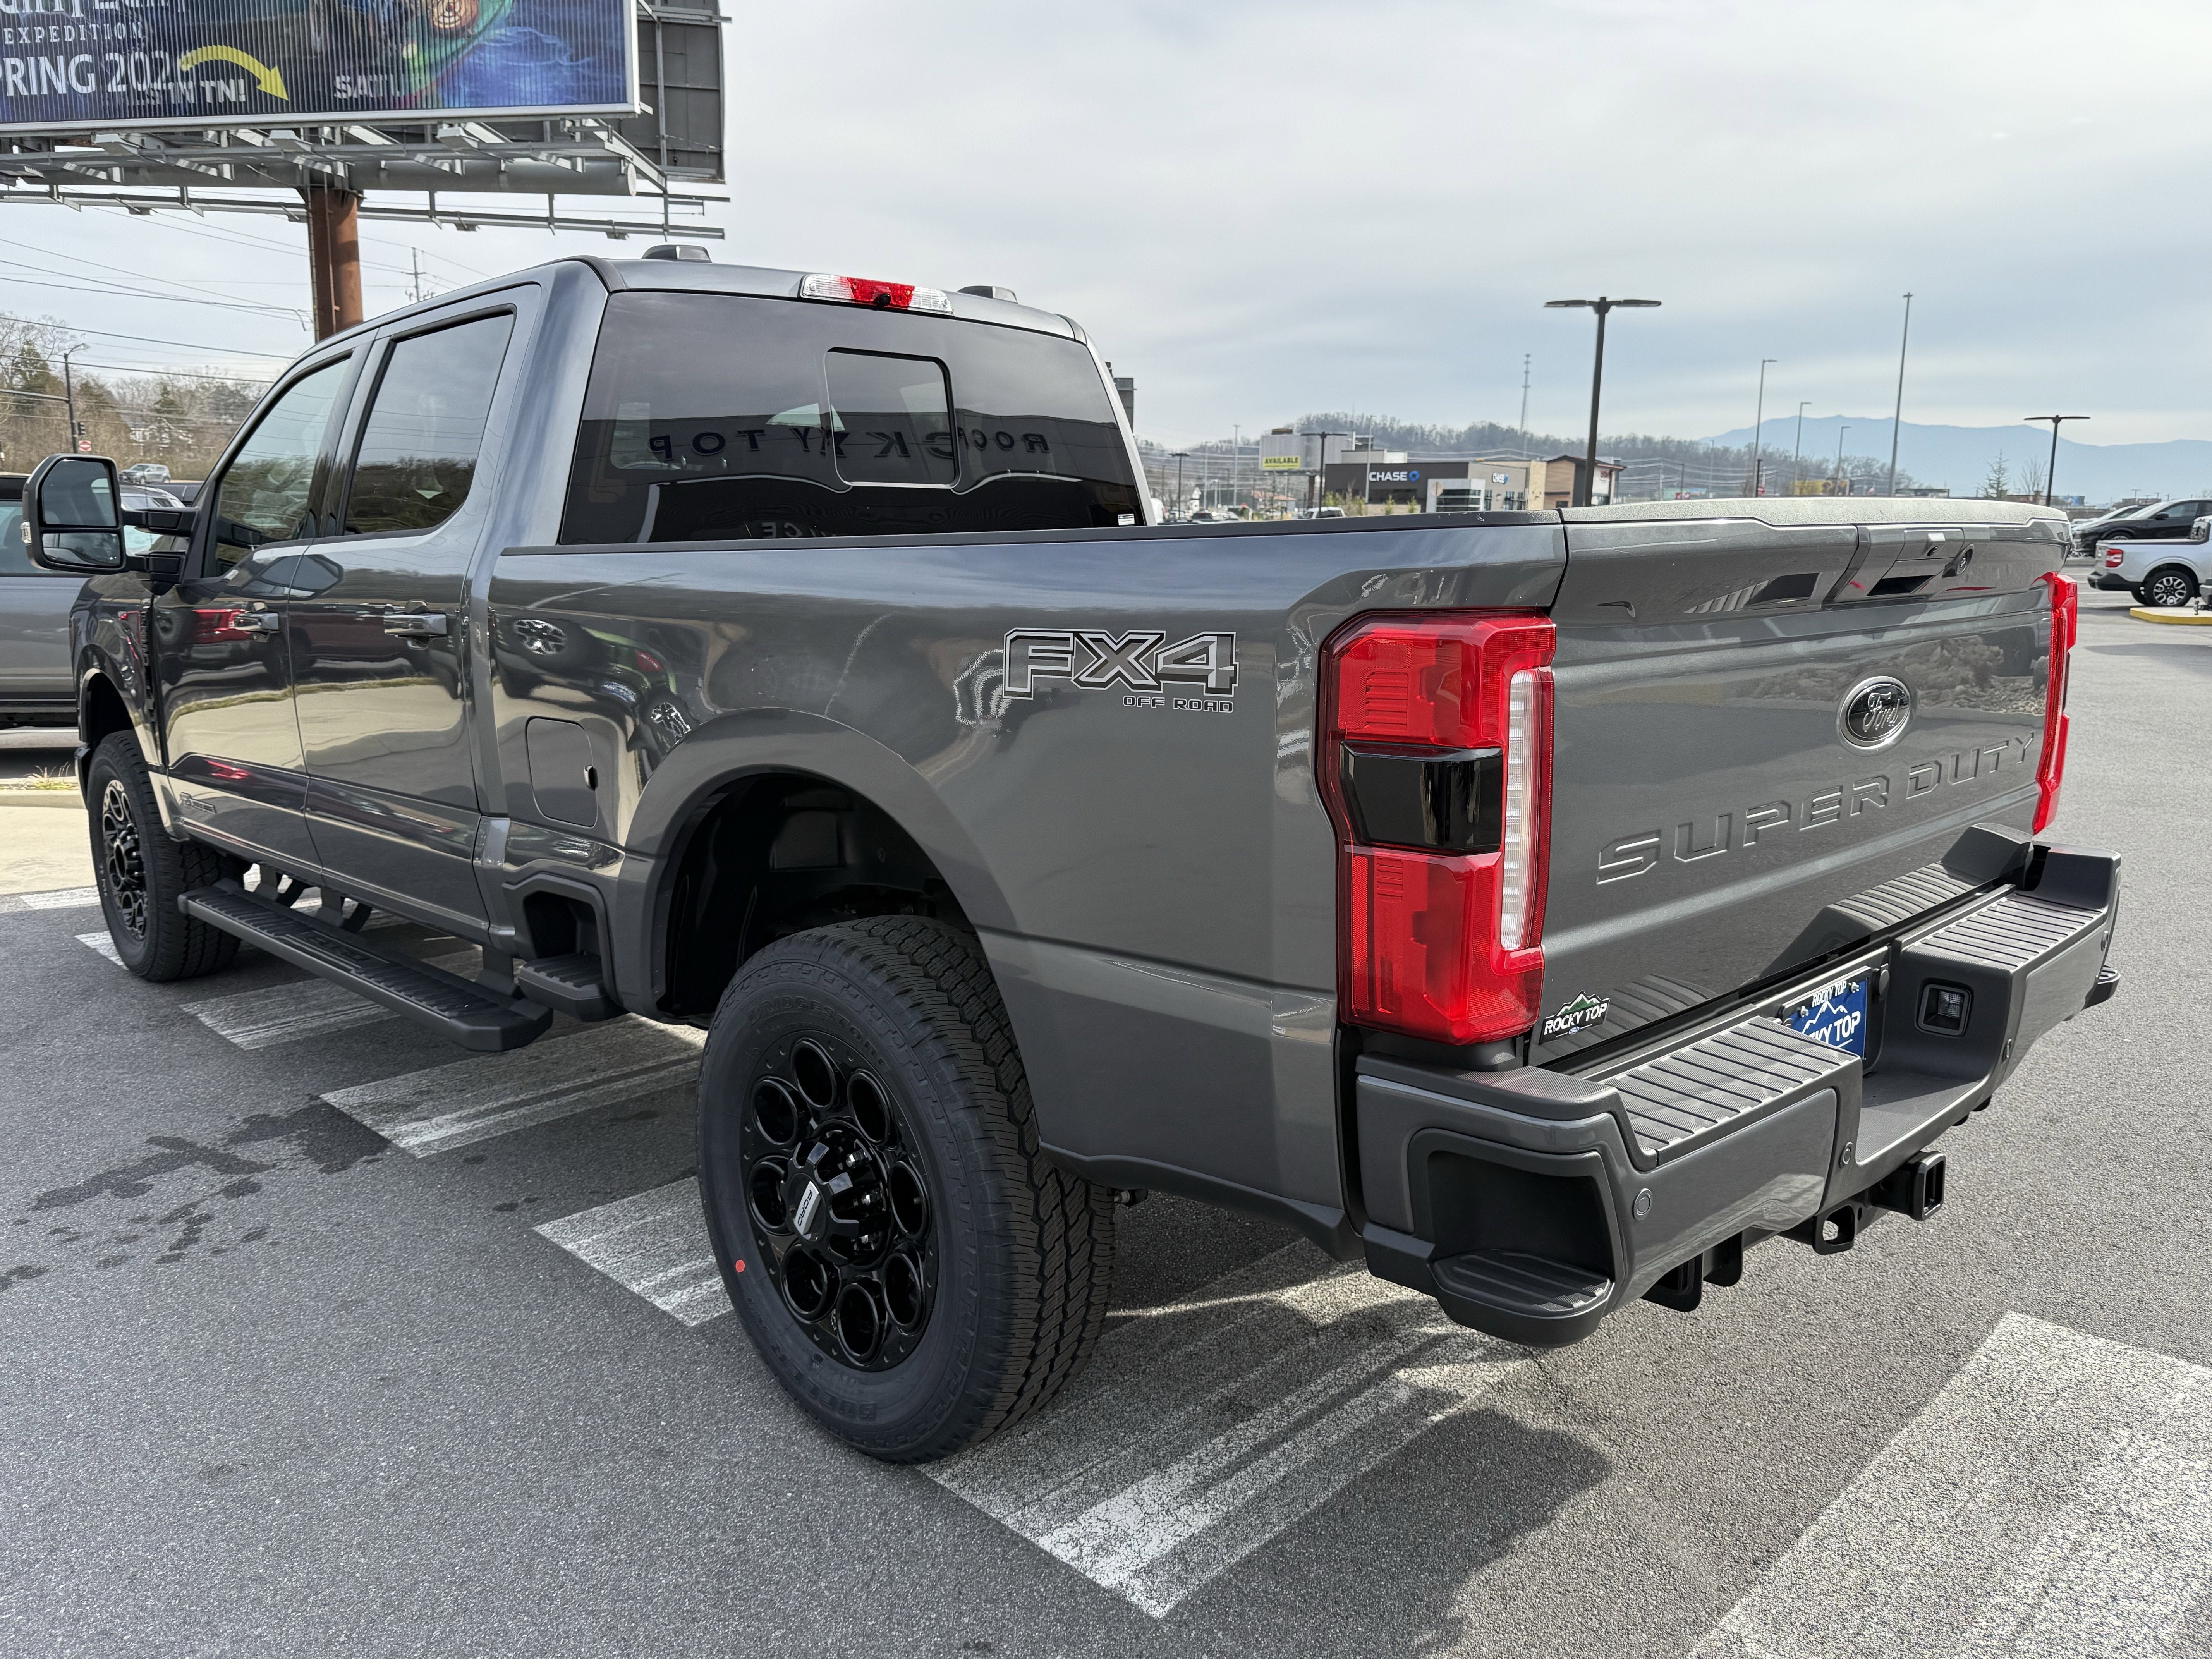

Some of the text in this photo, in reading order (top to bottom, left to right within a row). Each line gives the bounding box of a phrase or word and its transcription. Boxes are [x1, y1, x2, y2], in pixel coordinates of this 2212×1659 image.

[3, 22, 144, 45] EXPEDITION
[0, 54, 96, 96] RING
[199, 79, 246, 103] TN!
[1369, 471, 1408, 481] CHASE
[1003, 627, 1239, 700] FX4
[1123, 696, 1234, 713] OFF ROAD
[1862, 692, 1900, 732] Ford
[1596, 731, 2035, 884] SUPER DUTY
[1812, 980, 1847, 1008] ROCKY TOP
[747, 993, 892, 1073] BRIDGESTONE
[1544, 1003, 1607, 1035] ROCKY TOP
[1834, 1010, 1861, 1042] TOP
[797, 1189, 813, 1226] FORD
